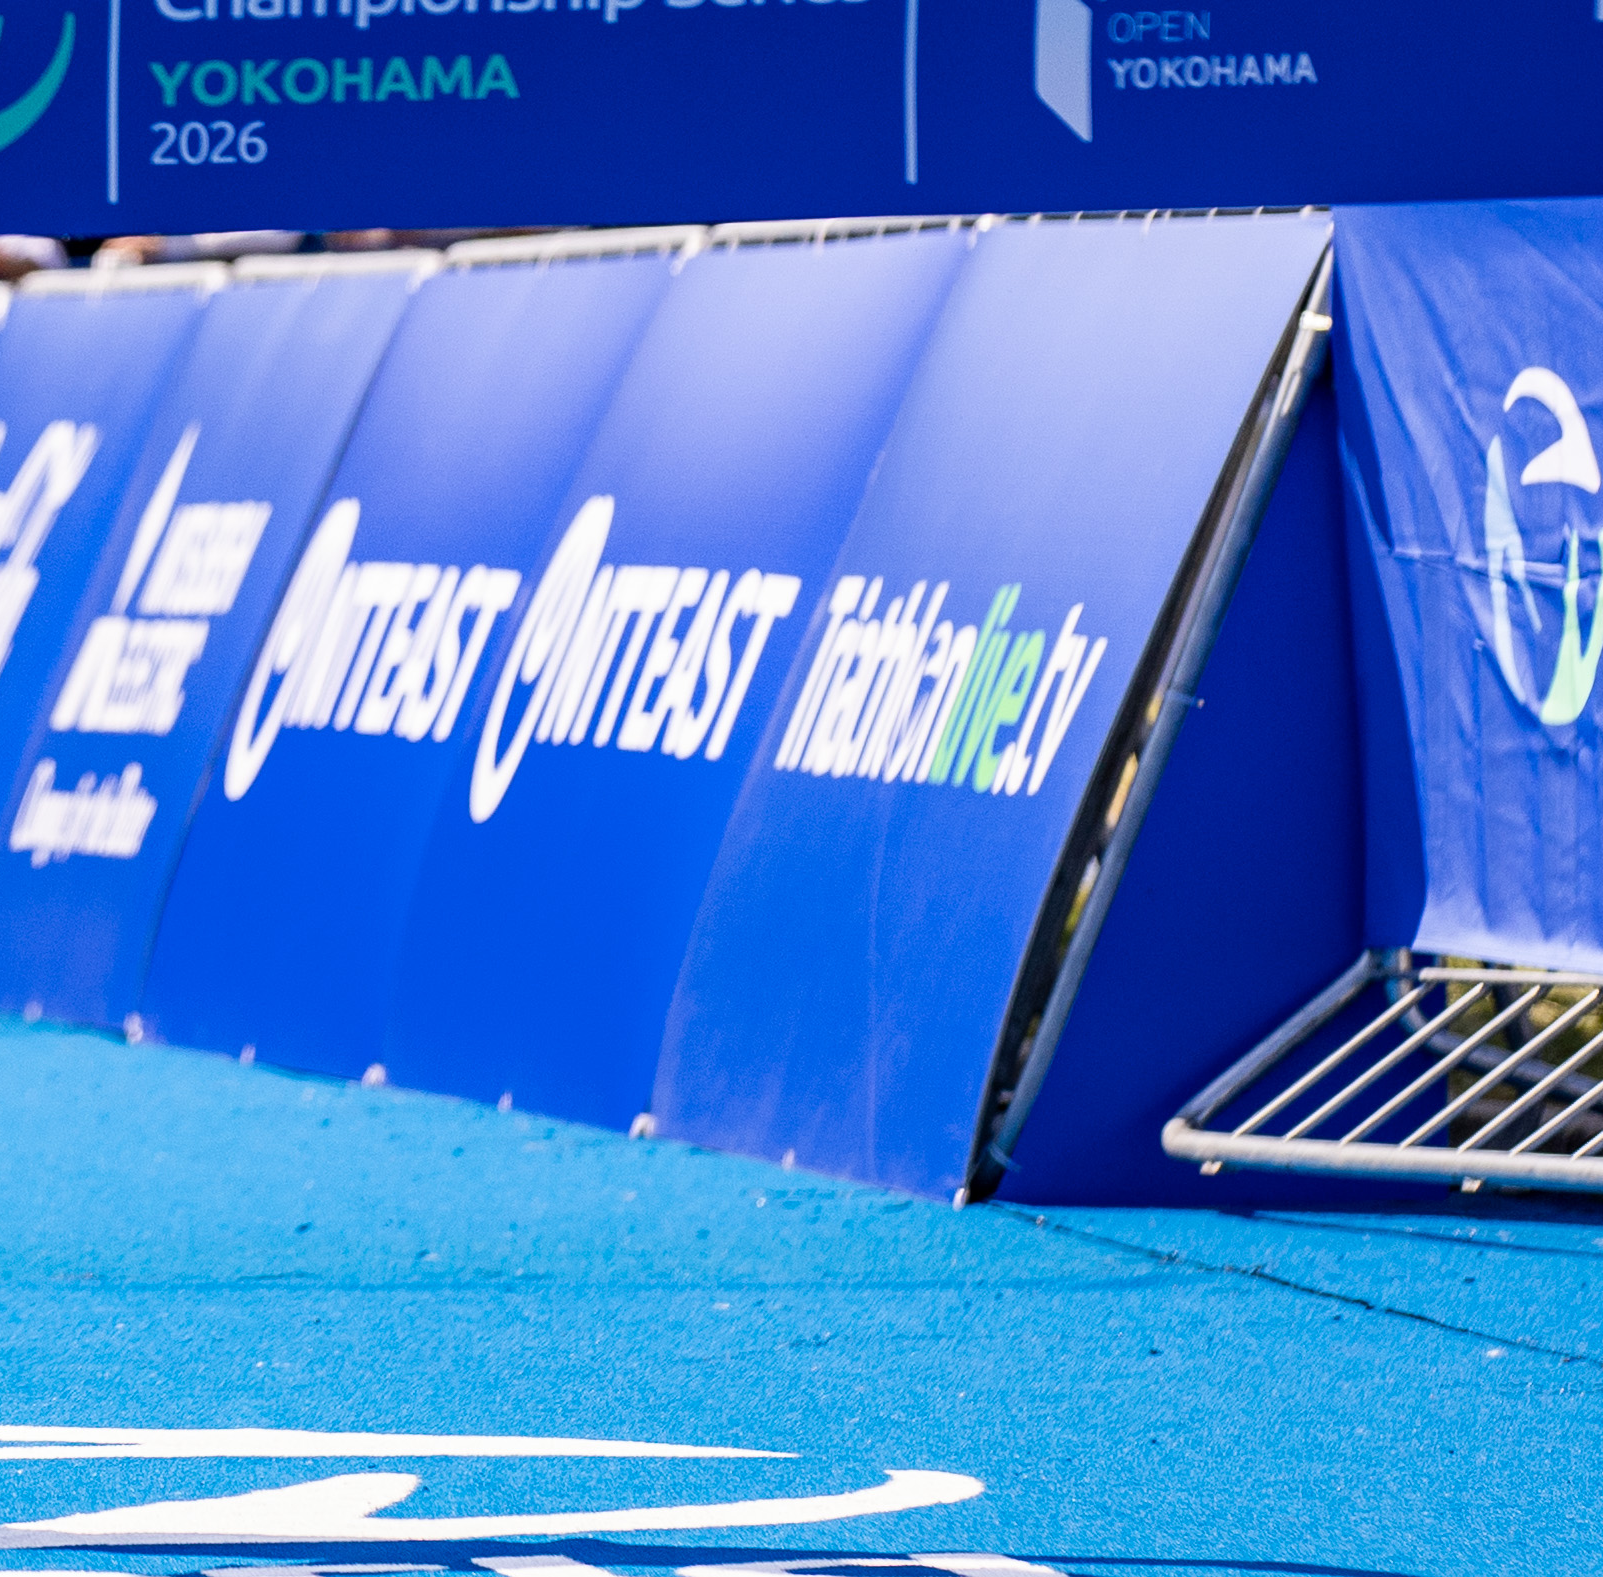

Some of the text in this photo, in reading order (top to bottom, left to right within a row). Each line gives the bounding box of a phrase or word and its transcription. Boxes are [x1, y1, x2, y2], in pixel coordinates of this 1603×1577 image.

[1107, 10, 1211, 44] OPEN
[150, 53, 520, 107] YOKOHAMA
[1107, 52, 1318, 90] YOKOHAMA
[150, 120, 268, 166] 2026
